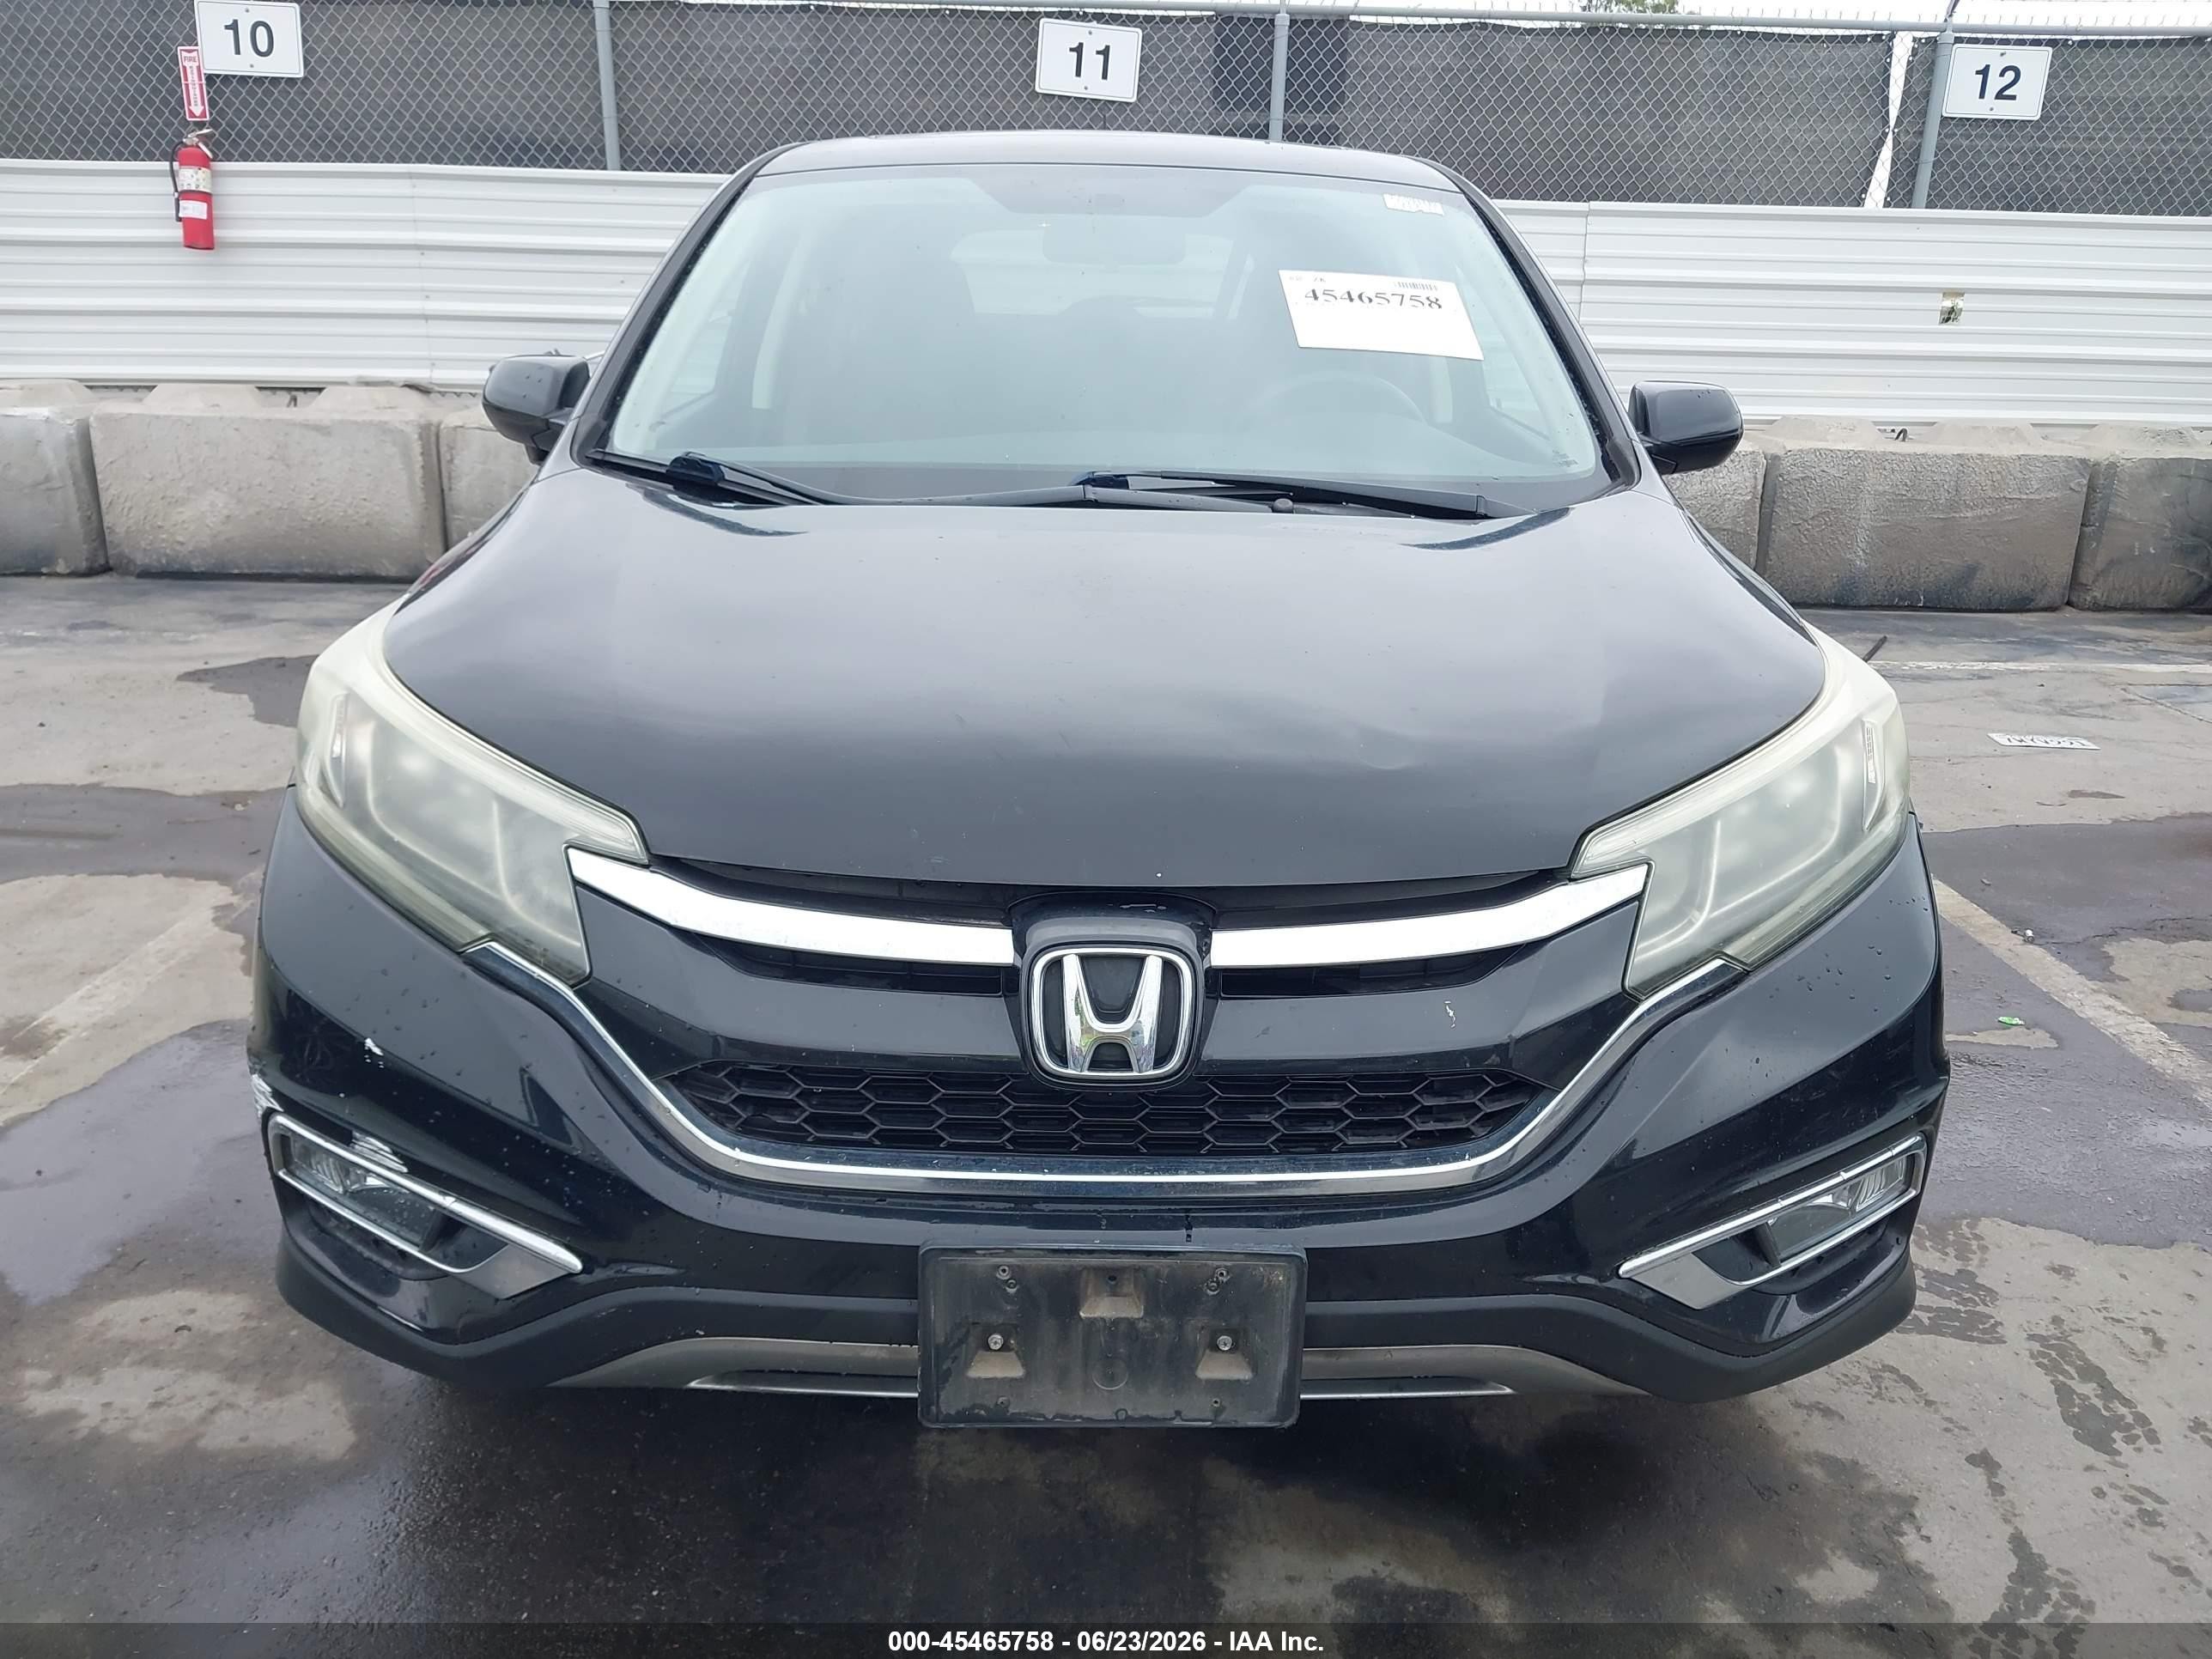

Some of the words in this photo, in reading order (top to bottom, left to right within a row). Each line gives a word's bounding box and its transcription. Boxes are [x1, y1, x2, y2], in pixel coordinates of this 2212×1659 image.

[223, 18, 275, 58] 10
[1068, 41, 1111, 81] 11
[1974, 64, 2021, 101] 12
[1304, 288, 1443, 310] 45465758
